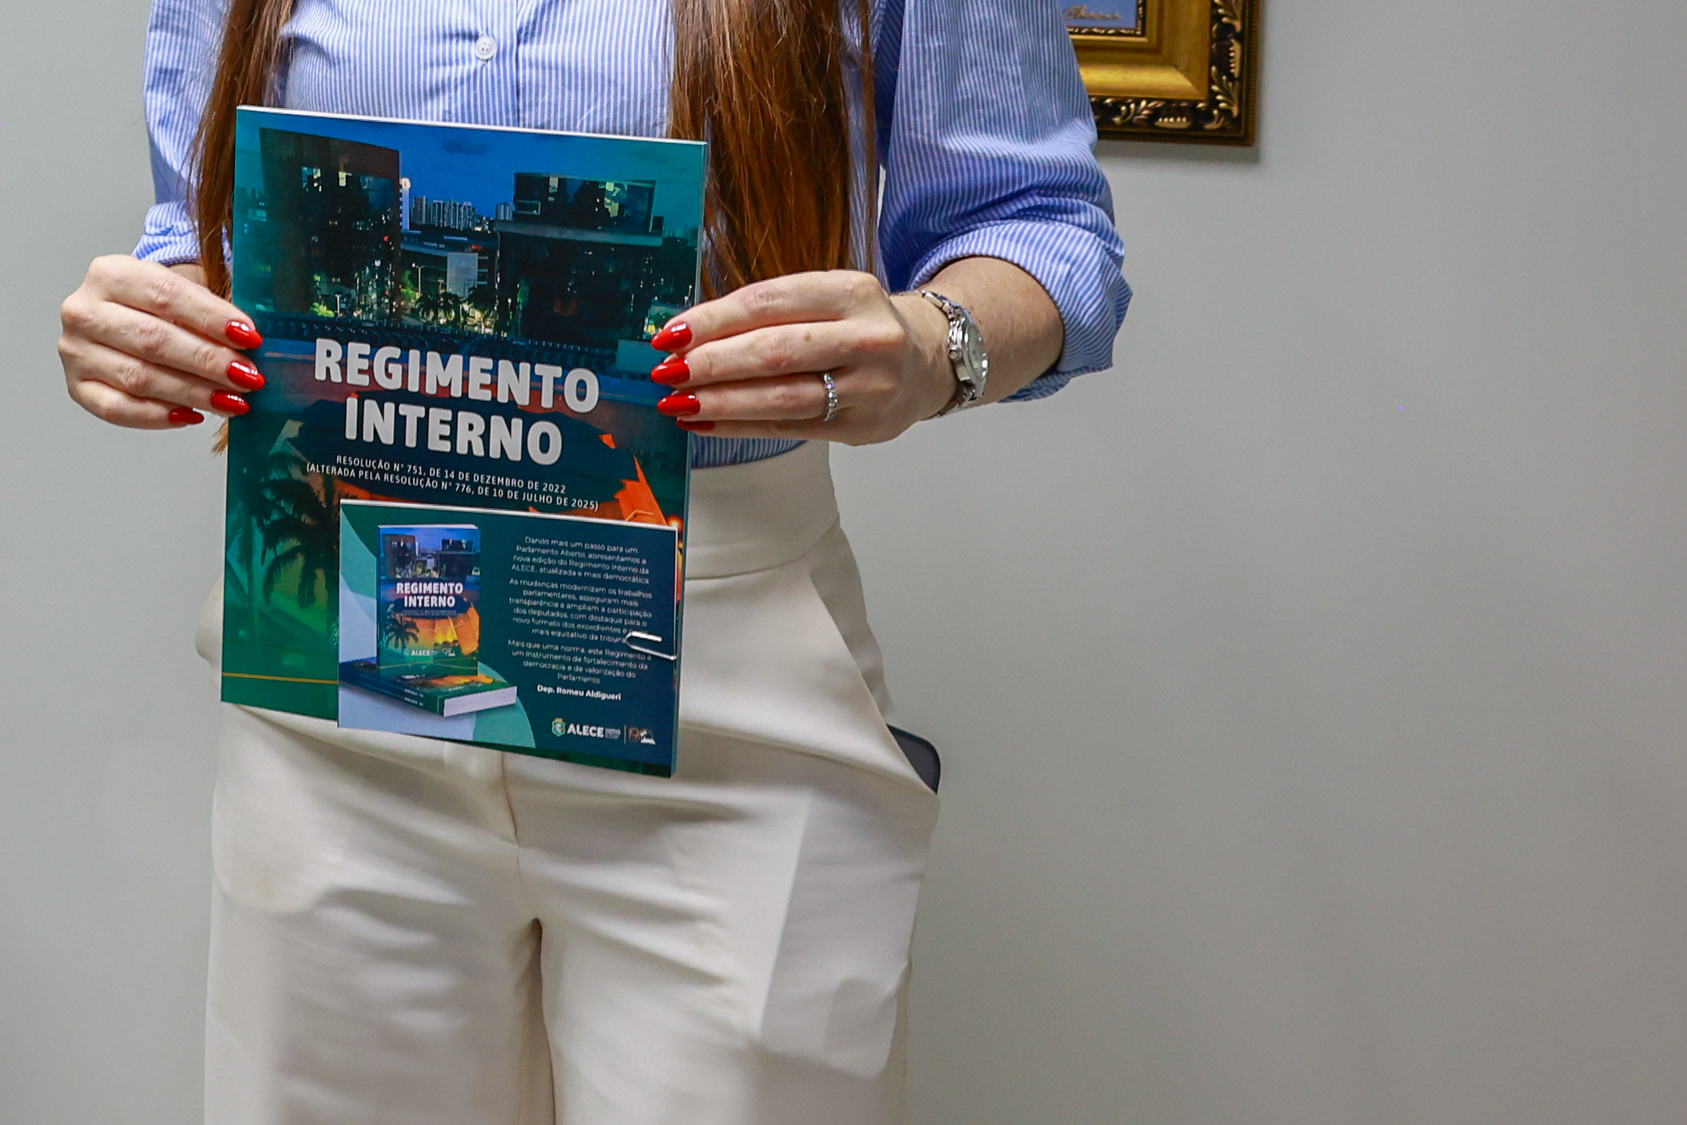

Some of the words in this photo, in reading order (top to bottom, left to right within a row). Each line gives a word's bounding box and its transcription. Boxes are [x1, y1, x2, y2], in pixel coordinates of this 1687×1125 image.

[314, 337, 600, 414] REGIMENTO
[345, 396, 563, 466] INTERNO
[306, 462, 356, 478] (ALTERADA
[358, 470, 381, 481] PELA
[383, 474, 438, 489] RESOLUÇÃO
[455, 483, 475, 495] 776,
[477, 487, 489, 496] DE
[493, 488, 504, 498] 10
[507, 490, 519, 500] DE
[522, 492, 553, 504] JULHO
[556, 496, 568, 506] DE
[571, 498, 599, 512] 2025)
[336, 455, 391, 471] RESOLUÇÃO
[407, 464, 426, 477] 751,
[429, 467, 441, 478] DE
[444, 469, 455, 480] 14
[458, 471, 470, 482] DE
[473, 473, 524, 489] DEZEMBRO
[527, 480, 539, 491] DE
[542, 483, 566, 494] 2022
[396, 582, 464, 595] REGIMENTO
[404, 595, 456, 608] INTERNO
[537, 684, 555, 694] Dep.
[556, 686, 584, 697] Romeu
[585, 689, 622, 701] Aldigueri
[567, 723, 604, 738] ALECE
